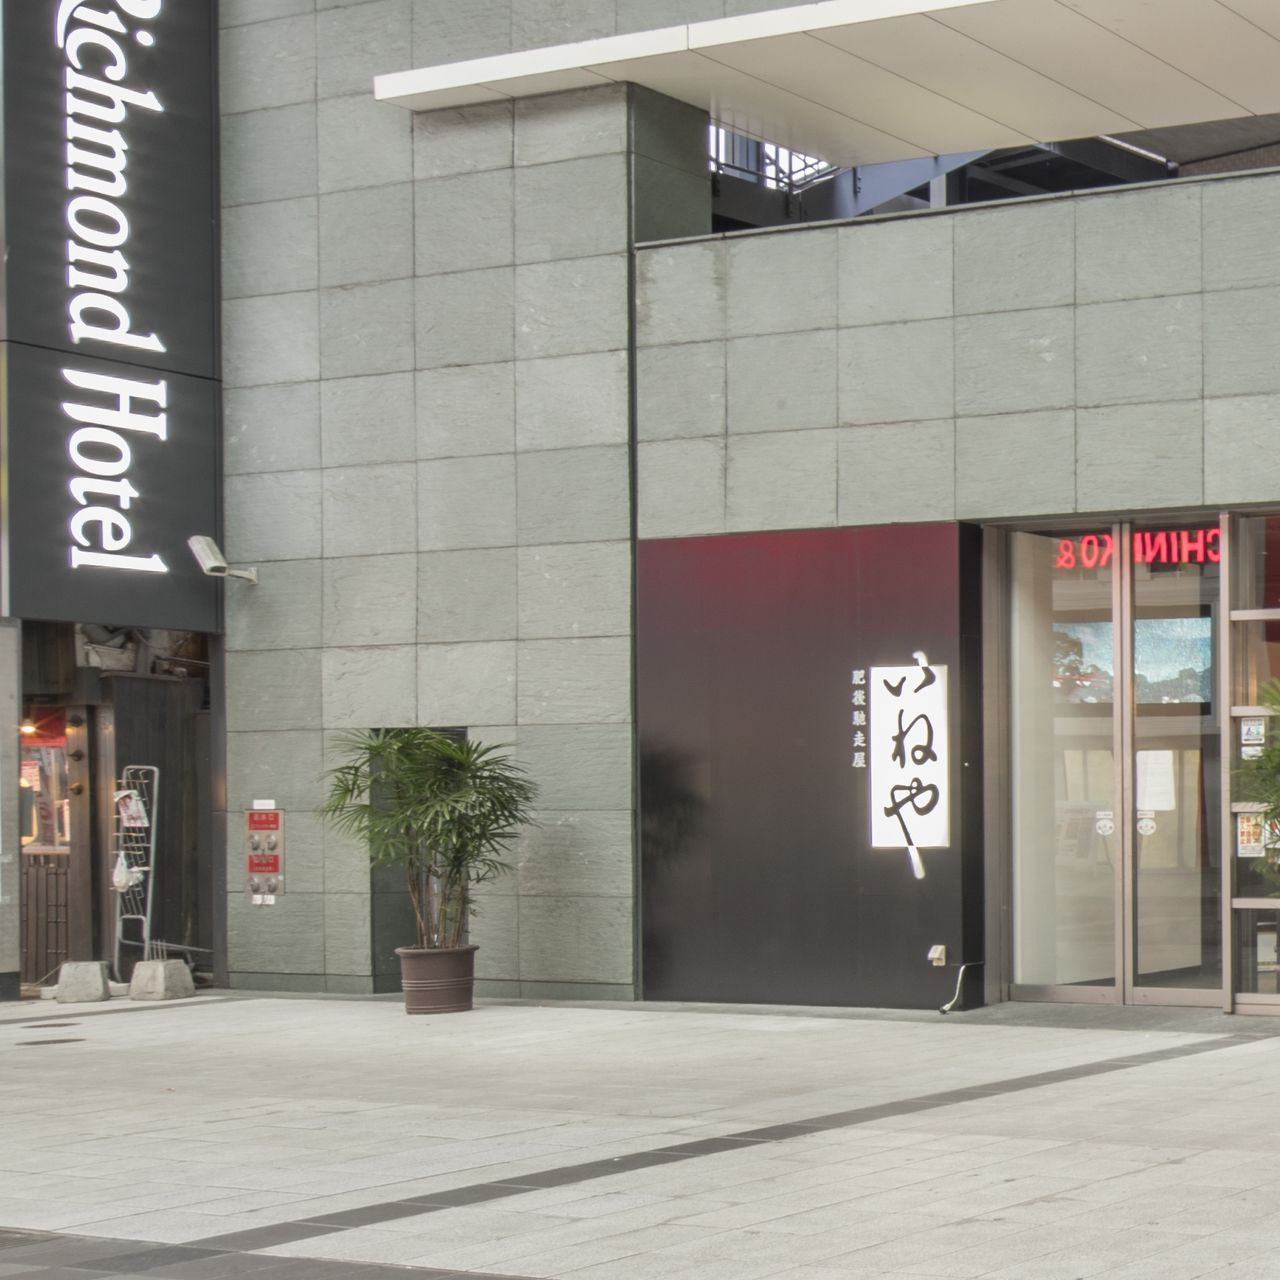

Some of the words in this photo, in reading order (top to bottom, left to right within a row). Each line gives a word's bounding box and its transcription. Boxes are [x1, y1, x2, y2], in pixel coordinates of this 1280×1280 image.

[62, 368, 169, 573] Hotel
[851, 669, 867, 768] 肥後馳走屋
[883, 650, 940, 880] いねや
